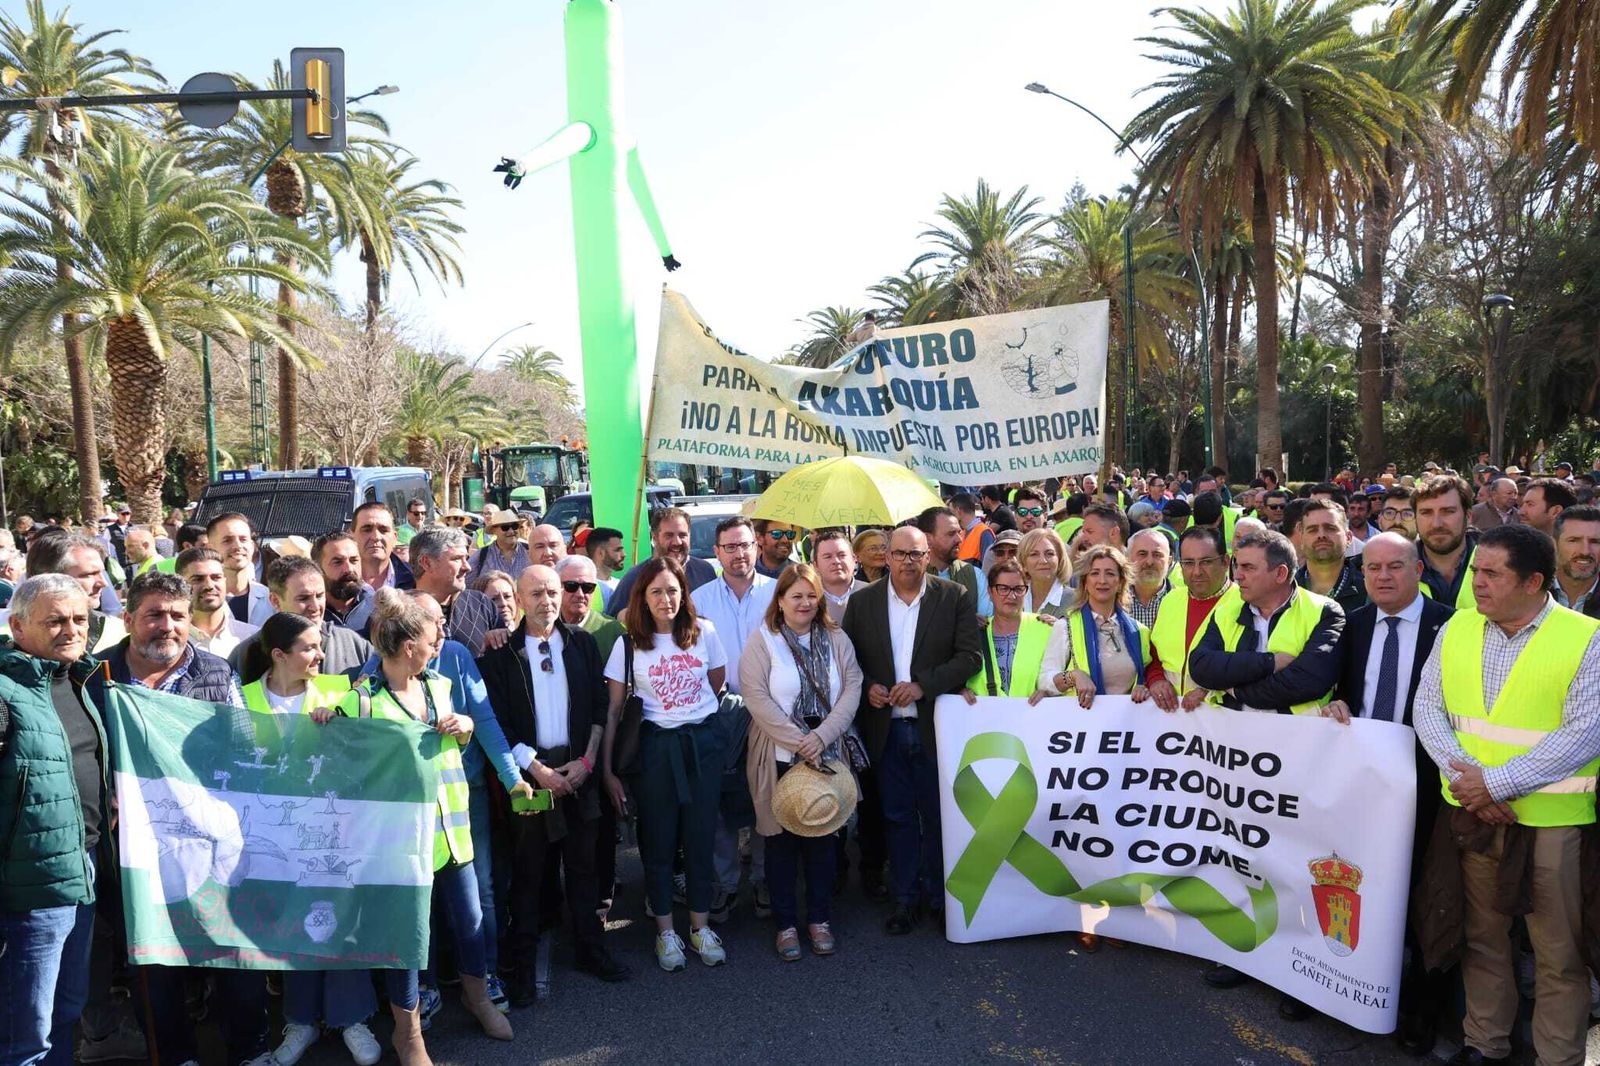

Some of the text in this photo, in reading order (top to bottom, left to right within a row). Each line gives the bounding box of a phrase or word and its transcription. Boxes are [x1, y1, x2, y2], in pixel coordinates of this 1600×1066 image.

[702, 364, 760, 391] PARA
[798, 372, 979, 416] AXARQUÍA
[681, 401, 721, 431] ¡NO
[726, 406, 741, 434] A
[750, 408, 776, 438] LA
[853, 420, 947, 452] IMPUESTA
[956, 422, 1001, 451] POR
[1005, 407, 1100, 446] EUROPA!
[657, 438, 751, 459] PLATAFORMA
[755, 448, 790, 463] PARA
[923, 455, 1001, 475] AGRICULTURA
[1009, 457, 1028, 470] EN
[1032, 455, 1049, 468] LA
[1048, 731, 1281, 777] SI EL CAMPO
[1047, 767, 1299, 819] NO PRODUCE
[1049, 803, 1270, 848] LA CIUDAD
[1051, 830, 1262, 881] NO COME.
[1335, 983, 1348, 998] LA
[1353, 989, 1390, 1009] REAL
